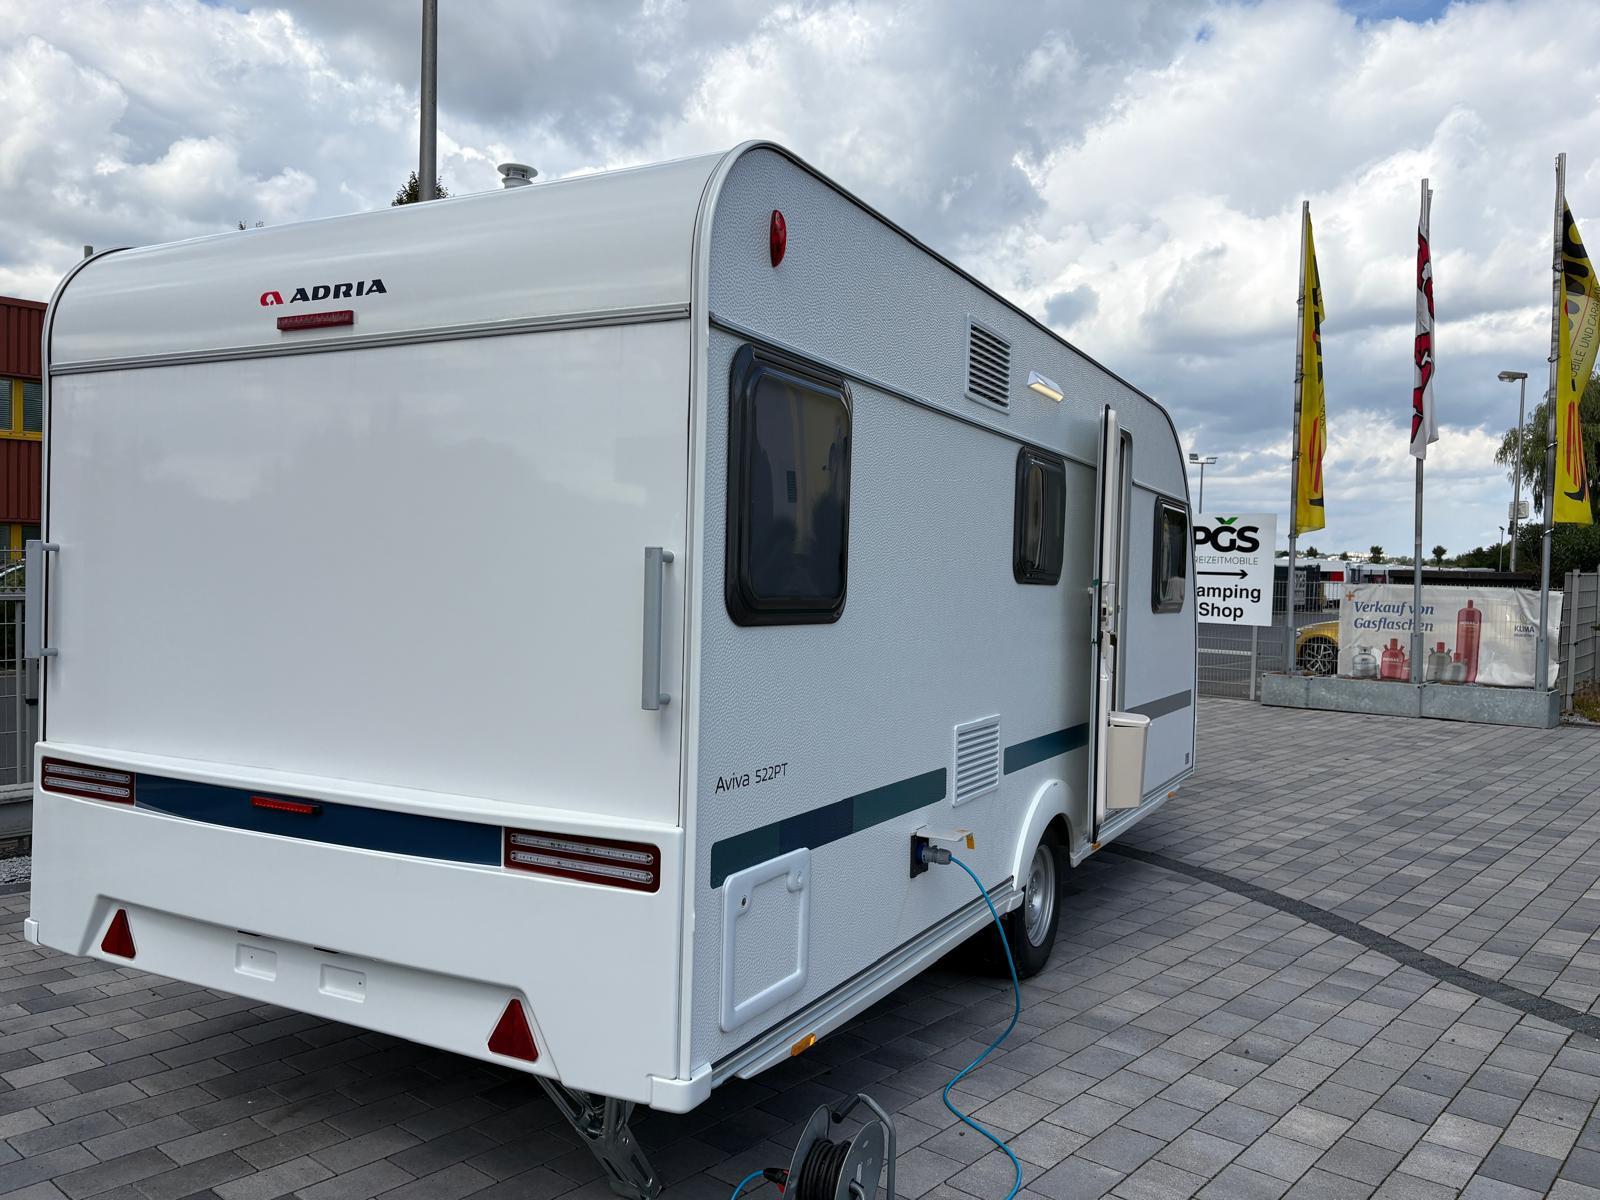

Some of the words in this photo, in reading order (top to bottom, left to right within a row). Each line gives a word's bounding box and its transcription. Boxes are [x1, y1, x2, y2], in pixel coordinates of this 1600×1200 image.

[289, 278, 388, 304] ADRIA
[1580, 327, 1594, 348] UND
[1196, 584, 1262, 604] amping
[1198, 602, 1244, 622] Shop
[1354, 600, 1407, 616] Verkauf
[715, 772, 750, 794] Aviva
[755, 762, 788, 784] 522PT
